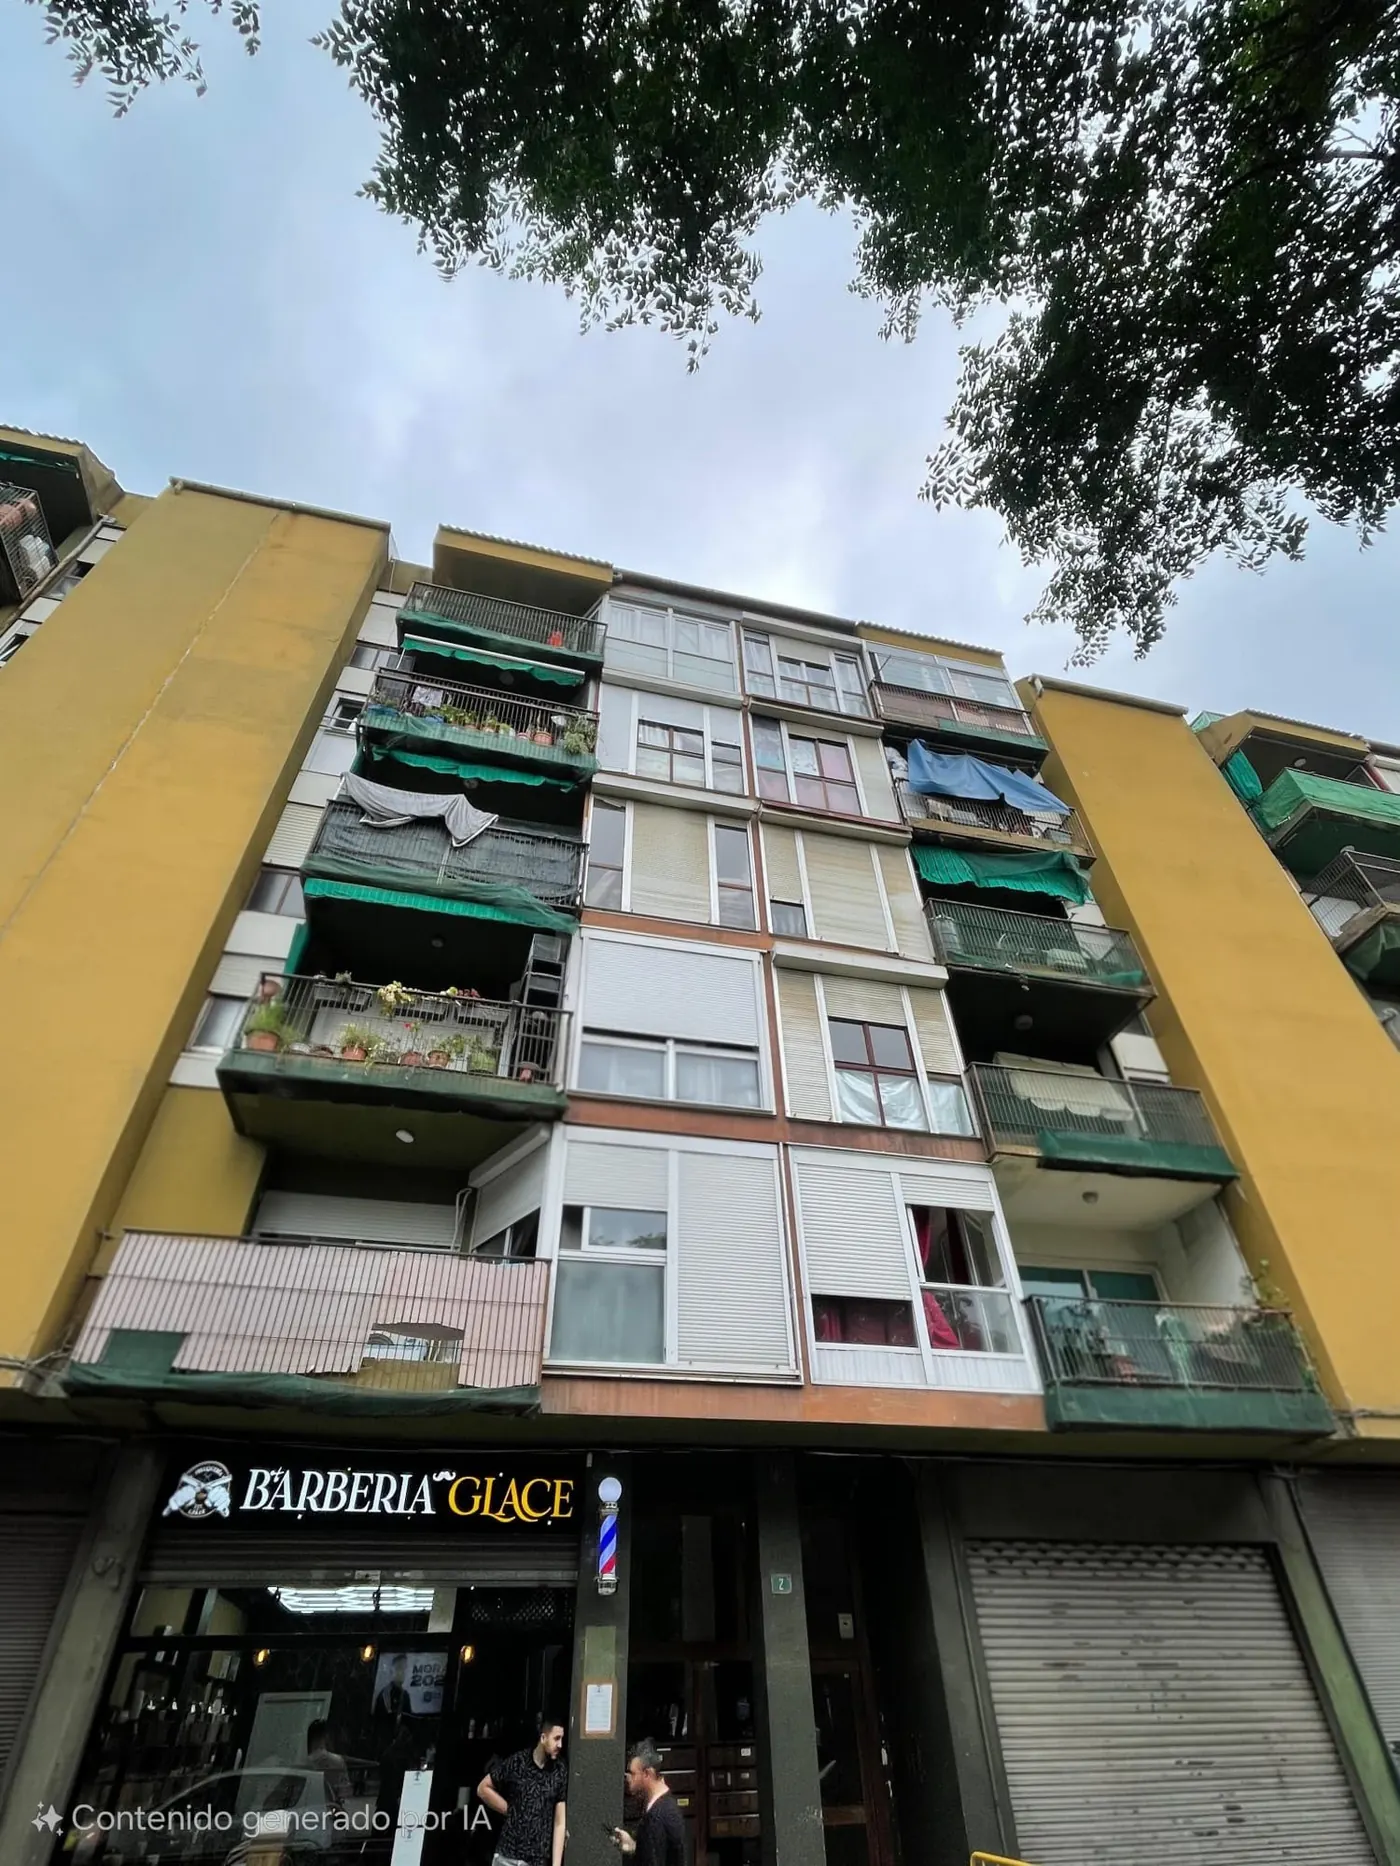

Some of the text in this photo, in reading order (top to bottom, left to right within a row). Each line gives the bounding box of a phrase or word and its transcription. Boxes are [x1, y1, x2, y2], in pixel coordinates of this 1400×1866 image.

[239, 1468, 574, 1523] BARBERIA GLACE
[778, 1577, 784, 1591] 2
